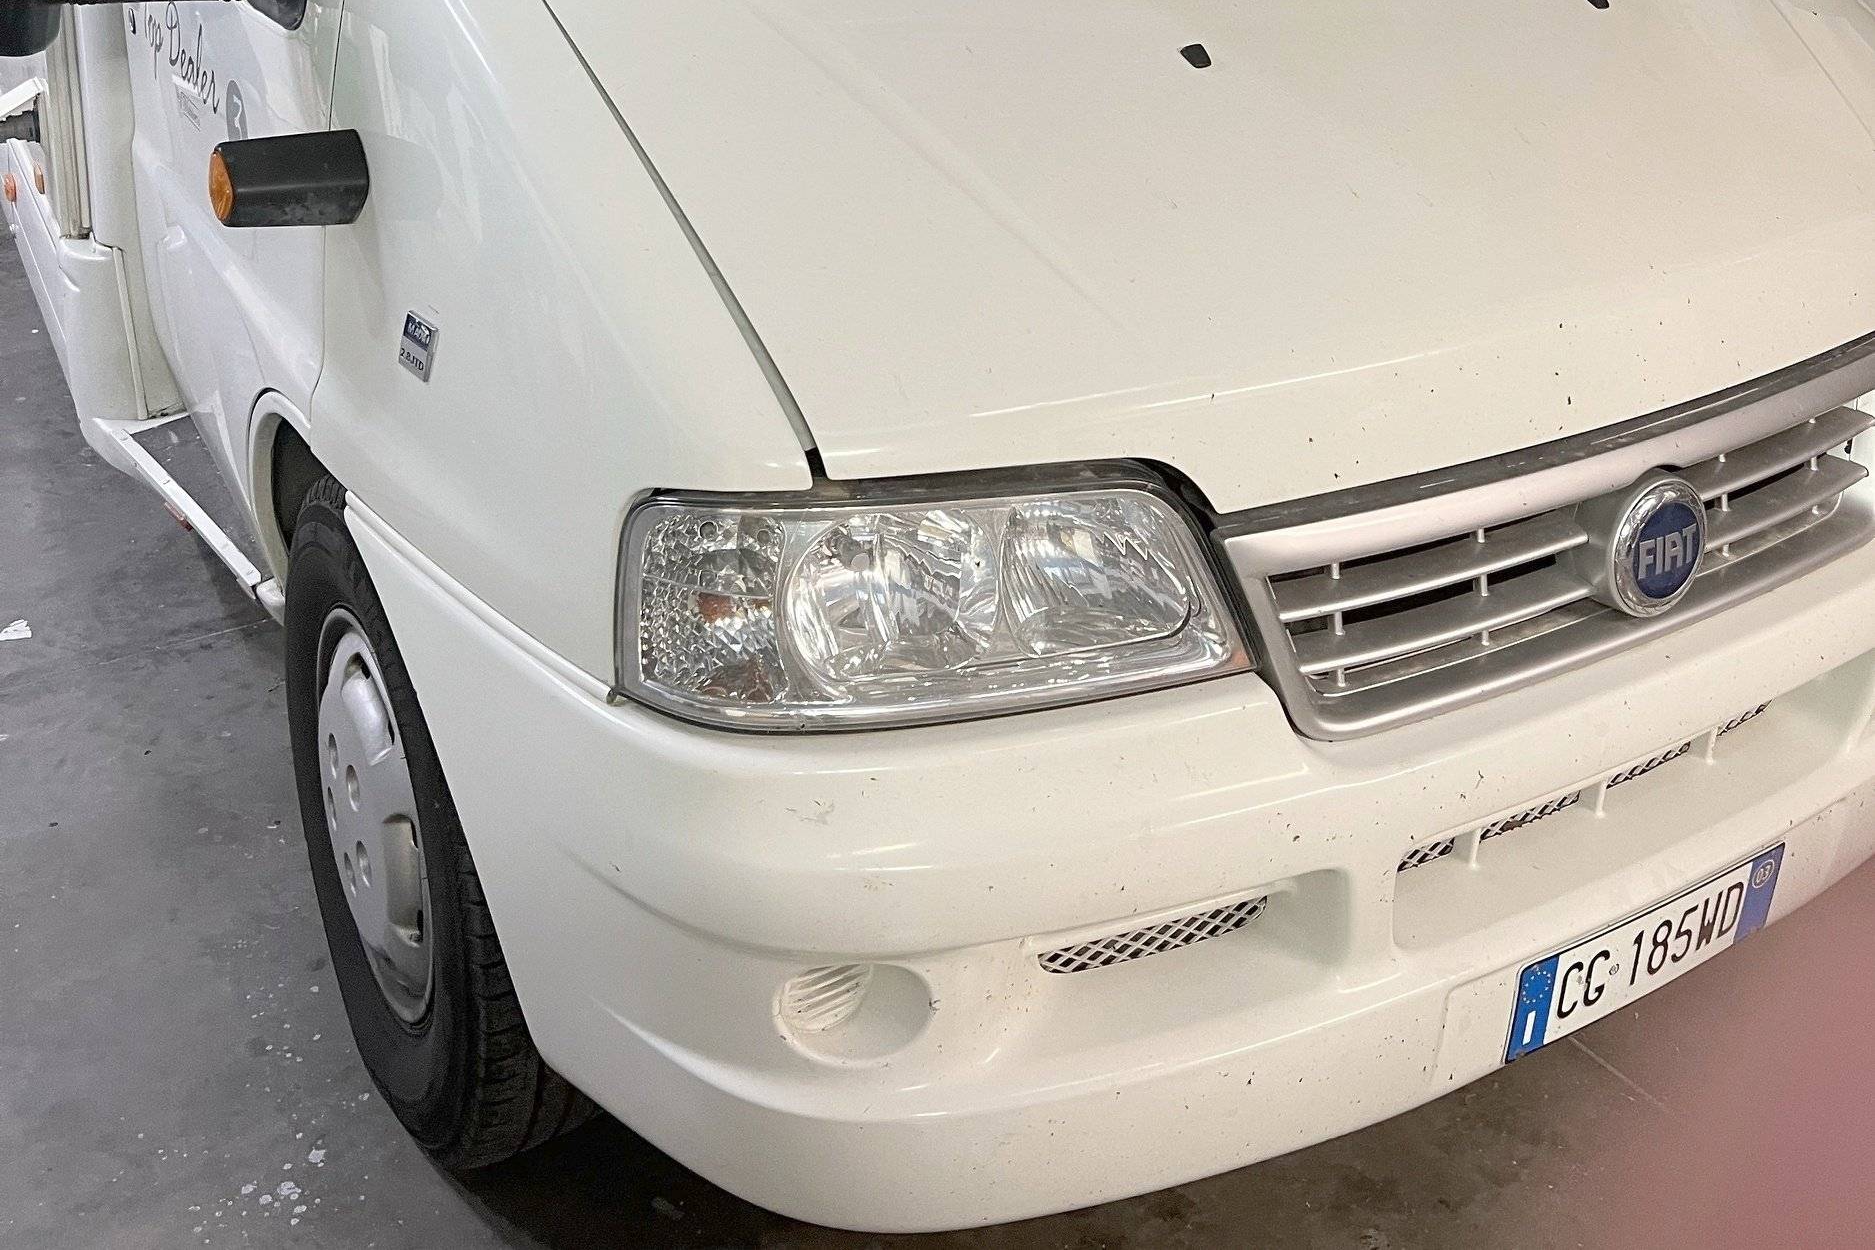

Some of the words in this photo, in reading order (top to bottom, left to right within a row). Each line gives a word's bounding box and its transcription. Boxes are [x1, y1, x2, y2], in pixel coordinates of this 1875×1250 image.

[165, 1, 220, 114] Dealer
[1638, 522, 1697, 579] FIAT
[1557, 949, 1610, 1019] CG
[1630, 881, 1745, 985] 185WD
